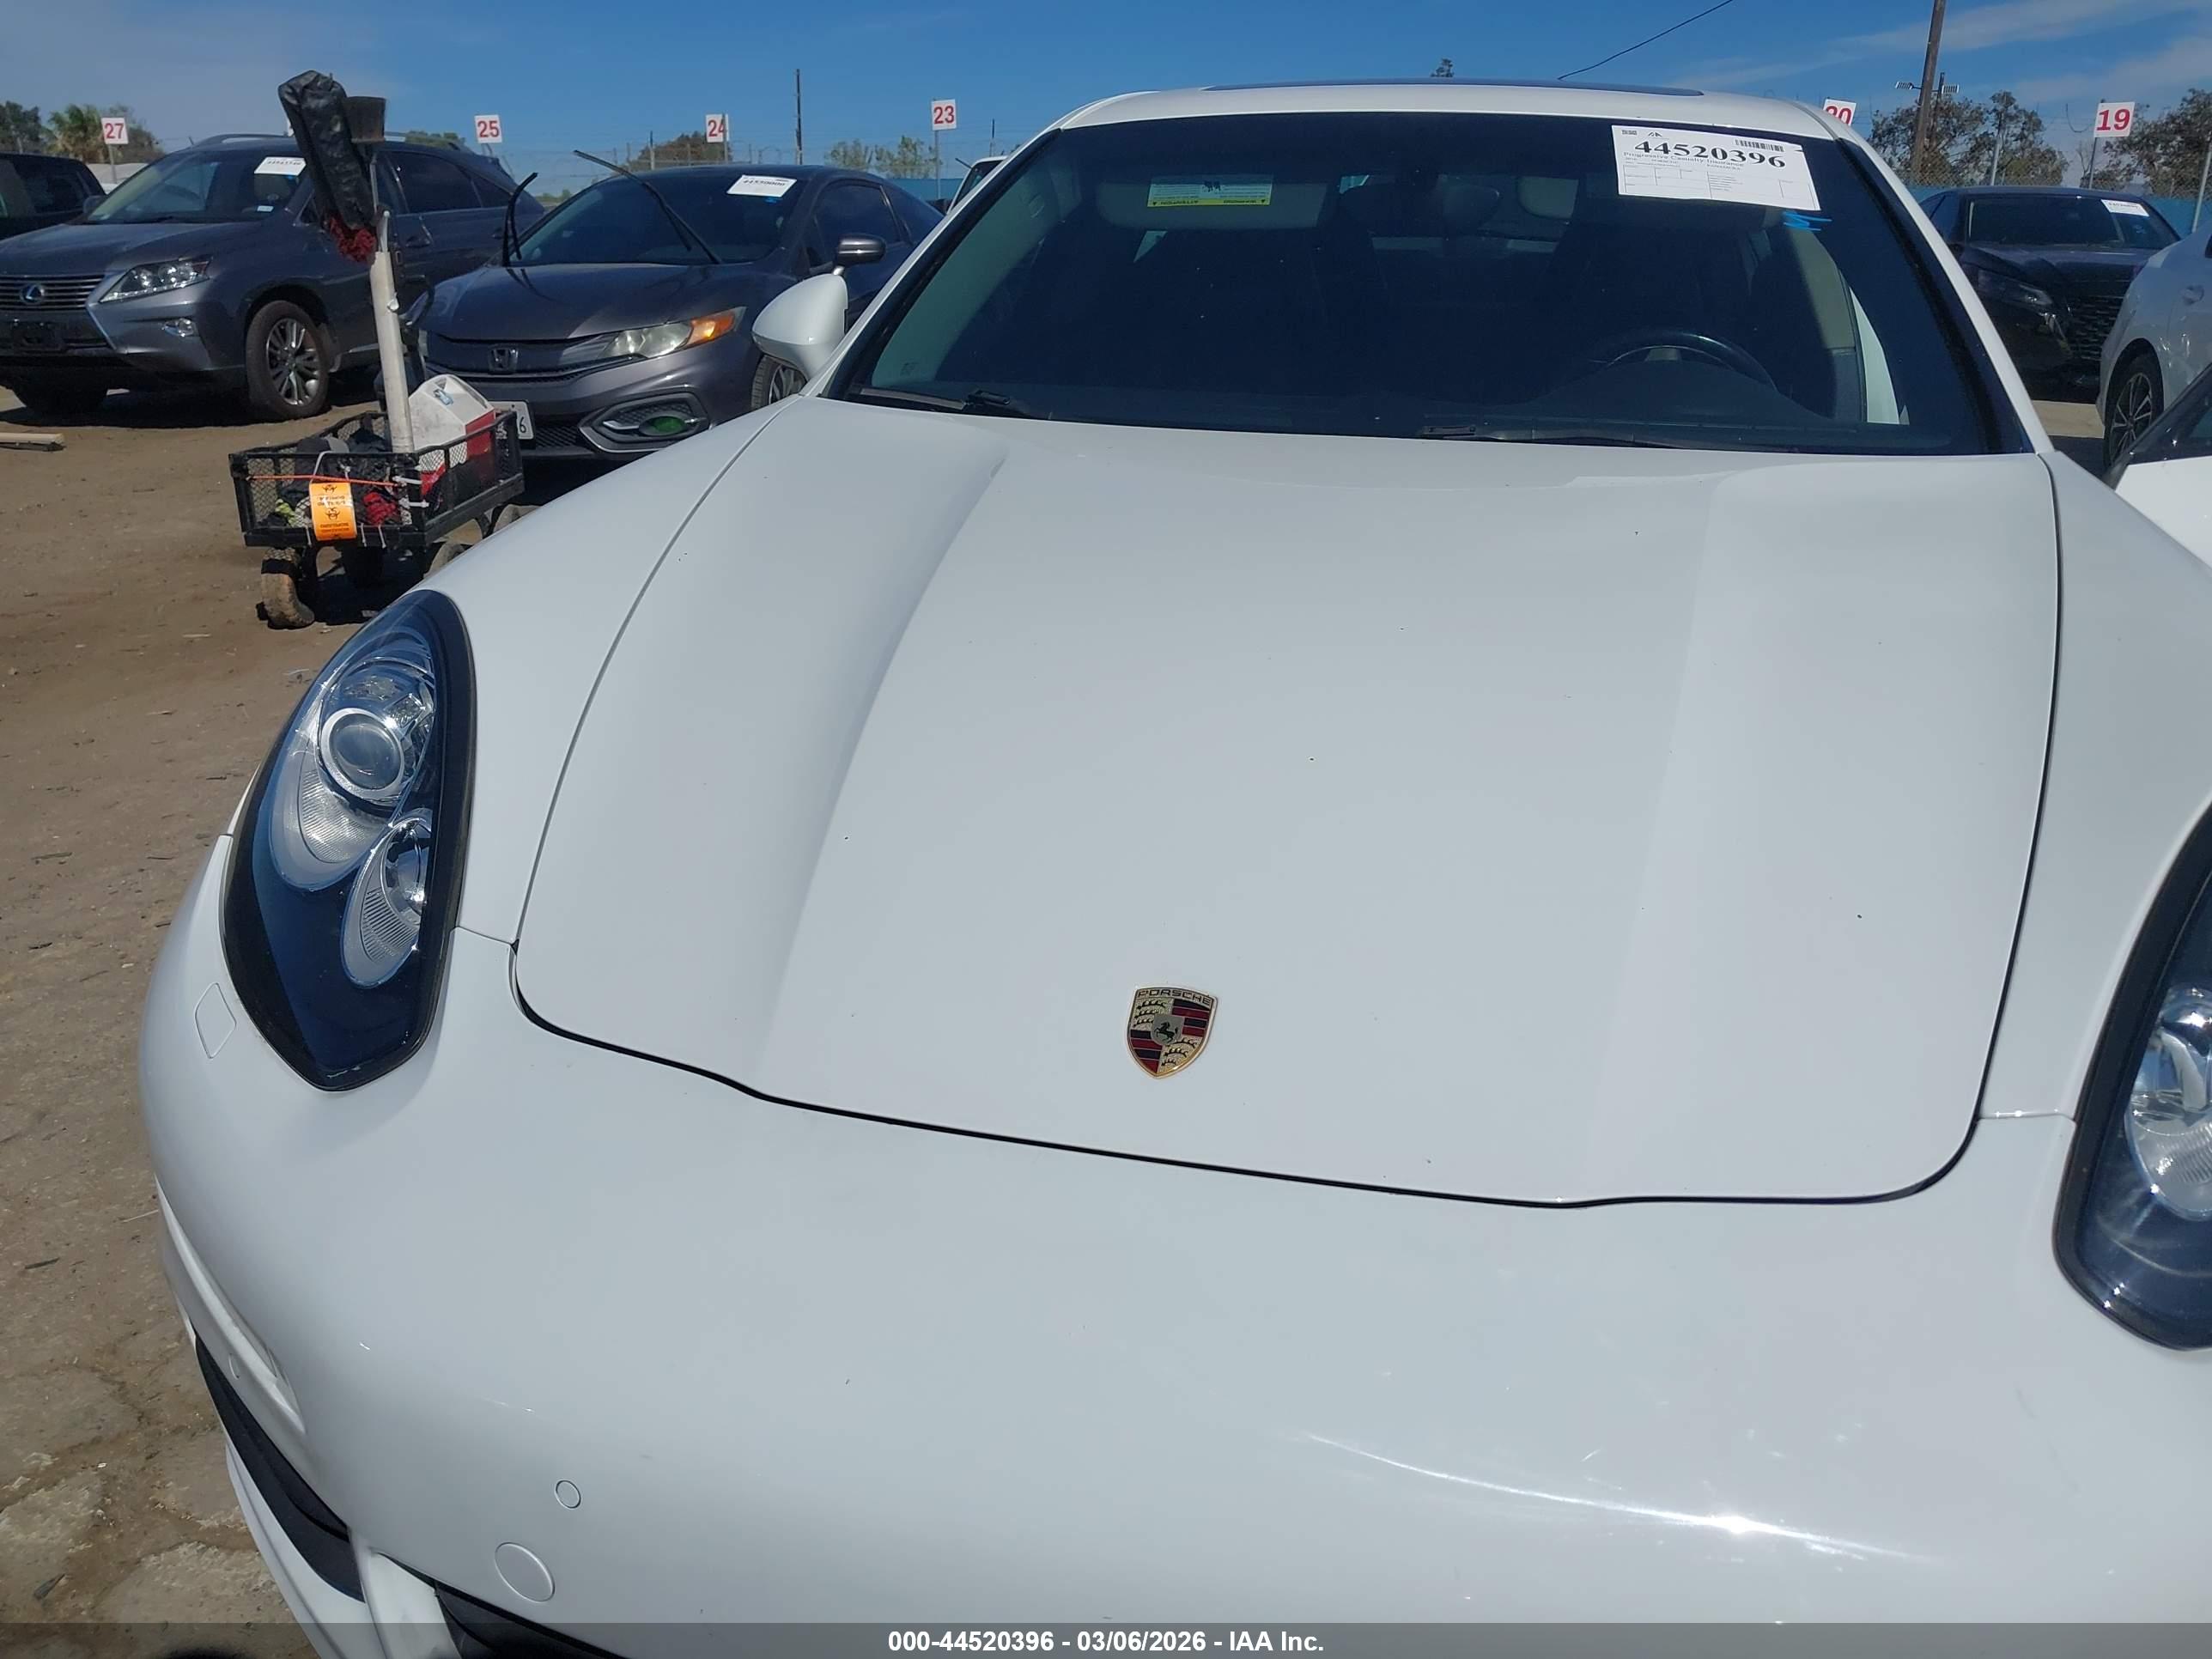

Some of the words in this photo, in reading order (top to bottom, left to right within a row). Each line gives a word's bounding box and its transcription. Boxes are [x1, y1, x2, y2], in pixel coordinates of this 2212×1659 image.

[933, 105, 954, 125] 23
[2096, 108, 2130, 131] 19
[105, 123, 125, 139] 27
[477, 120, 499, 137] 25
[1635, 141, 1785, 167] 44520396
[1139, 989, 1212, 1005] PORSCHE
